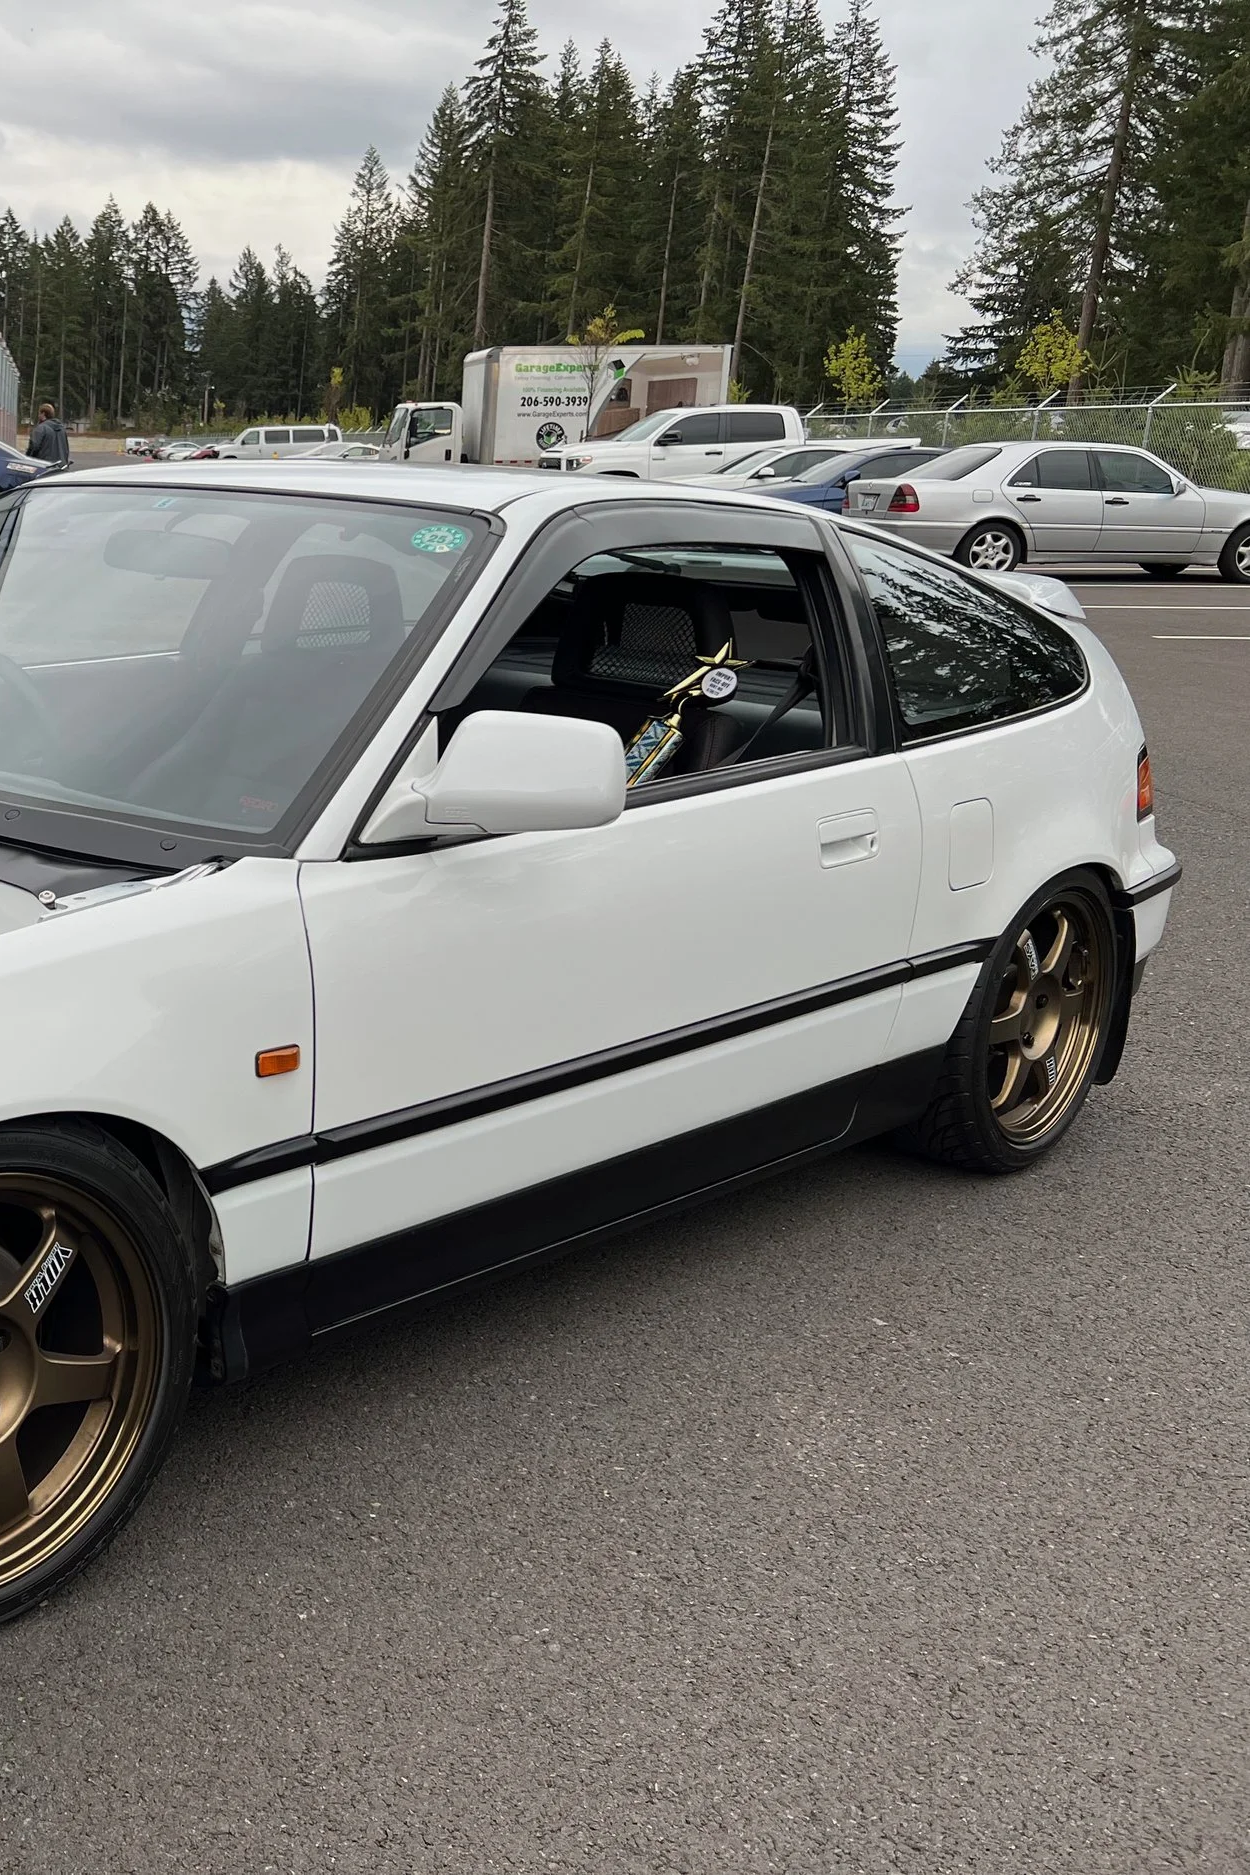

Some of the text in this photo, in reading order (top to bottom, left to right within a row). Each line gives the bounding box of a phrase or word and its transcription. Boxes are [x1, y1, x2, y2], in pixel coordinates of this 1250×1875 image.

[520, 396, 589, 407] 206-590-3939
[517, 411, 589, 419] www.GarageExperts.com
[426, 534, 448, 544] 25
